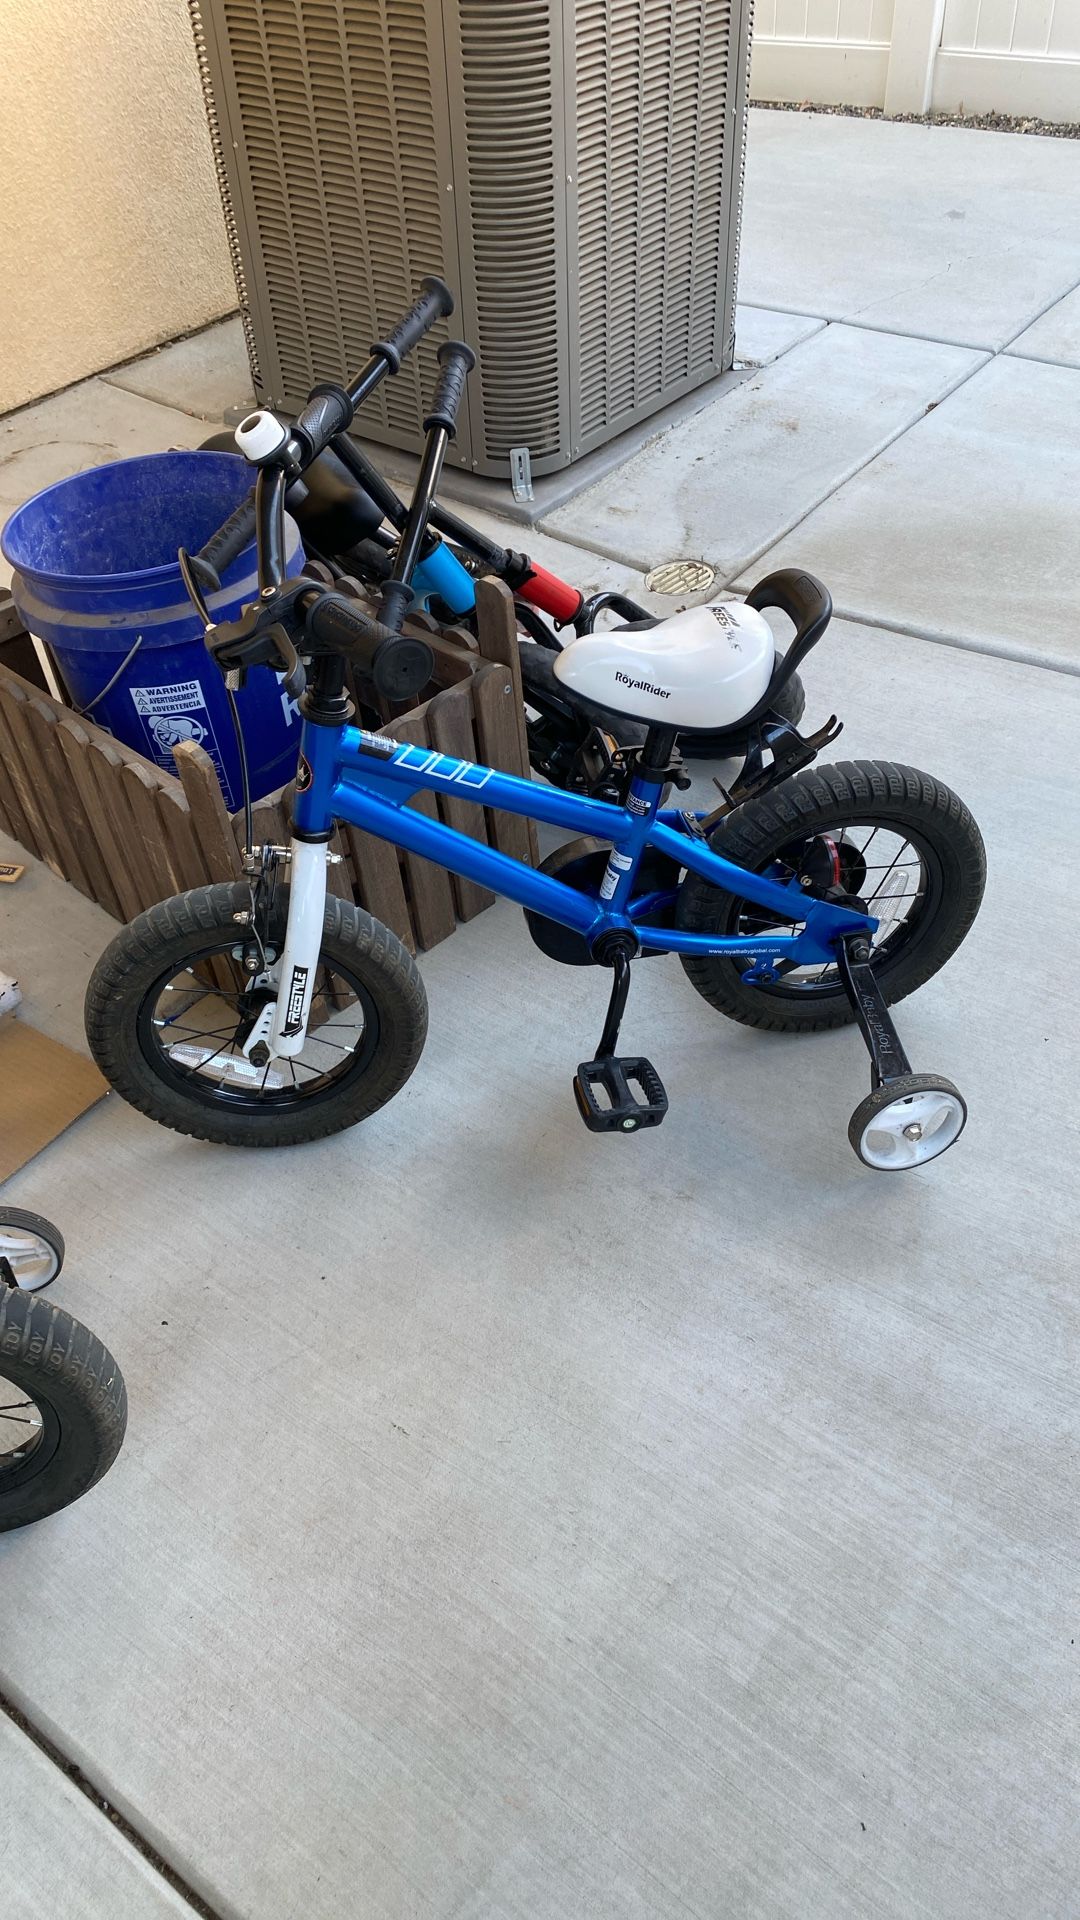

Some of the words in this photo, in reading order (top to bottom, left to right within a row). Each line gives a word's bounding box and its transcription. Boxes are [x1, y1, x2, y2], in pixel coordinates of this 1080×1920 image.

[145, 682, 197, 696] WARNING
[149, 691, 199, 704] AVERTISSEMENT
[152, 700, 201, 713] ADVERTENCIA
[288, 972, 307, 1024] FREESTYLE
